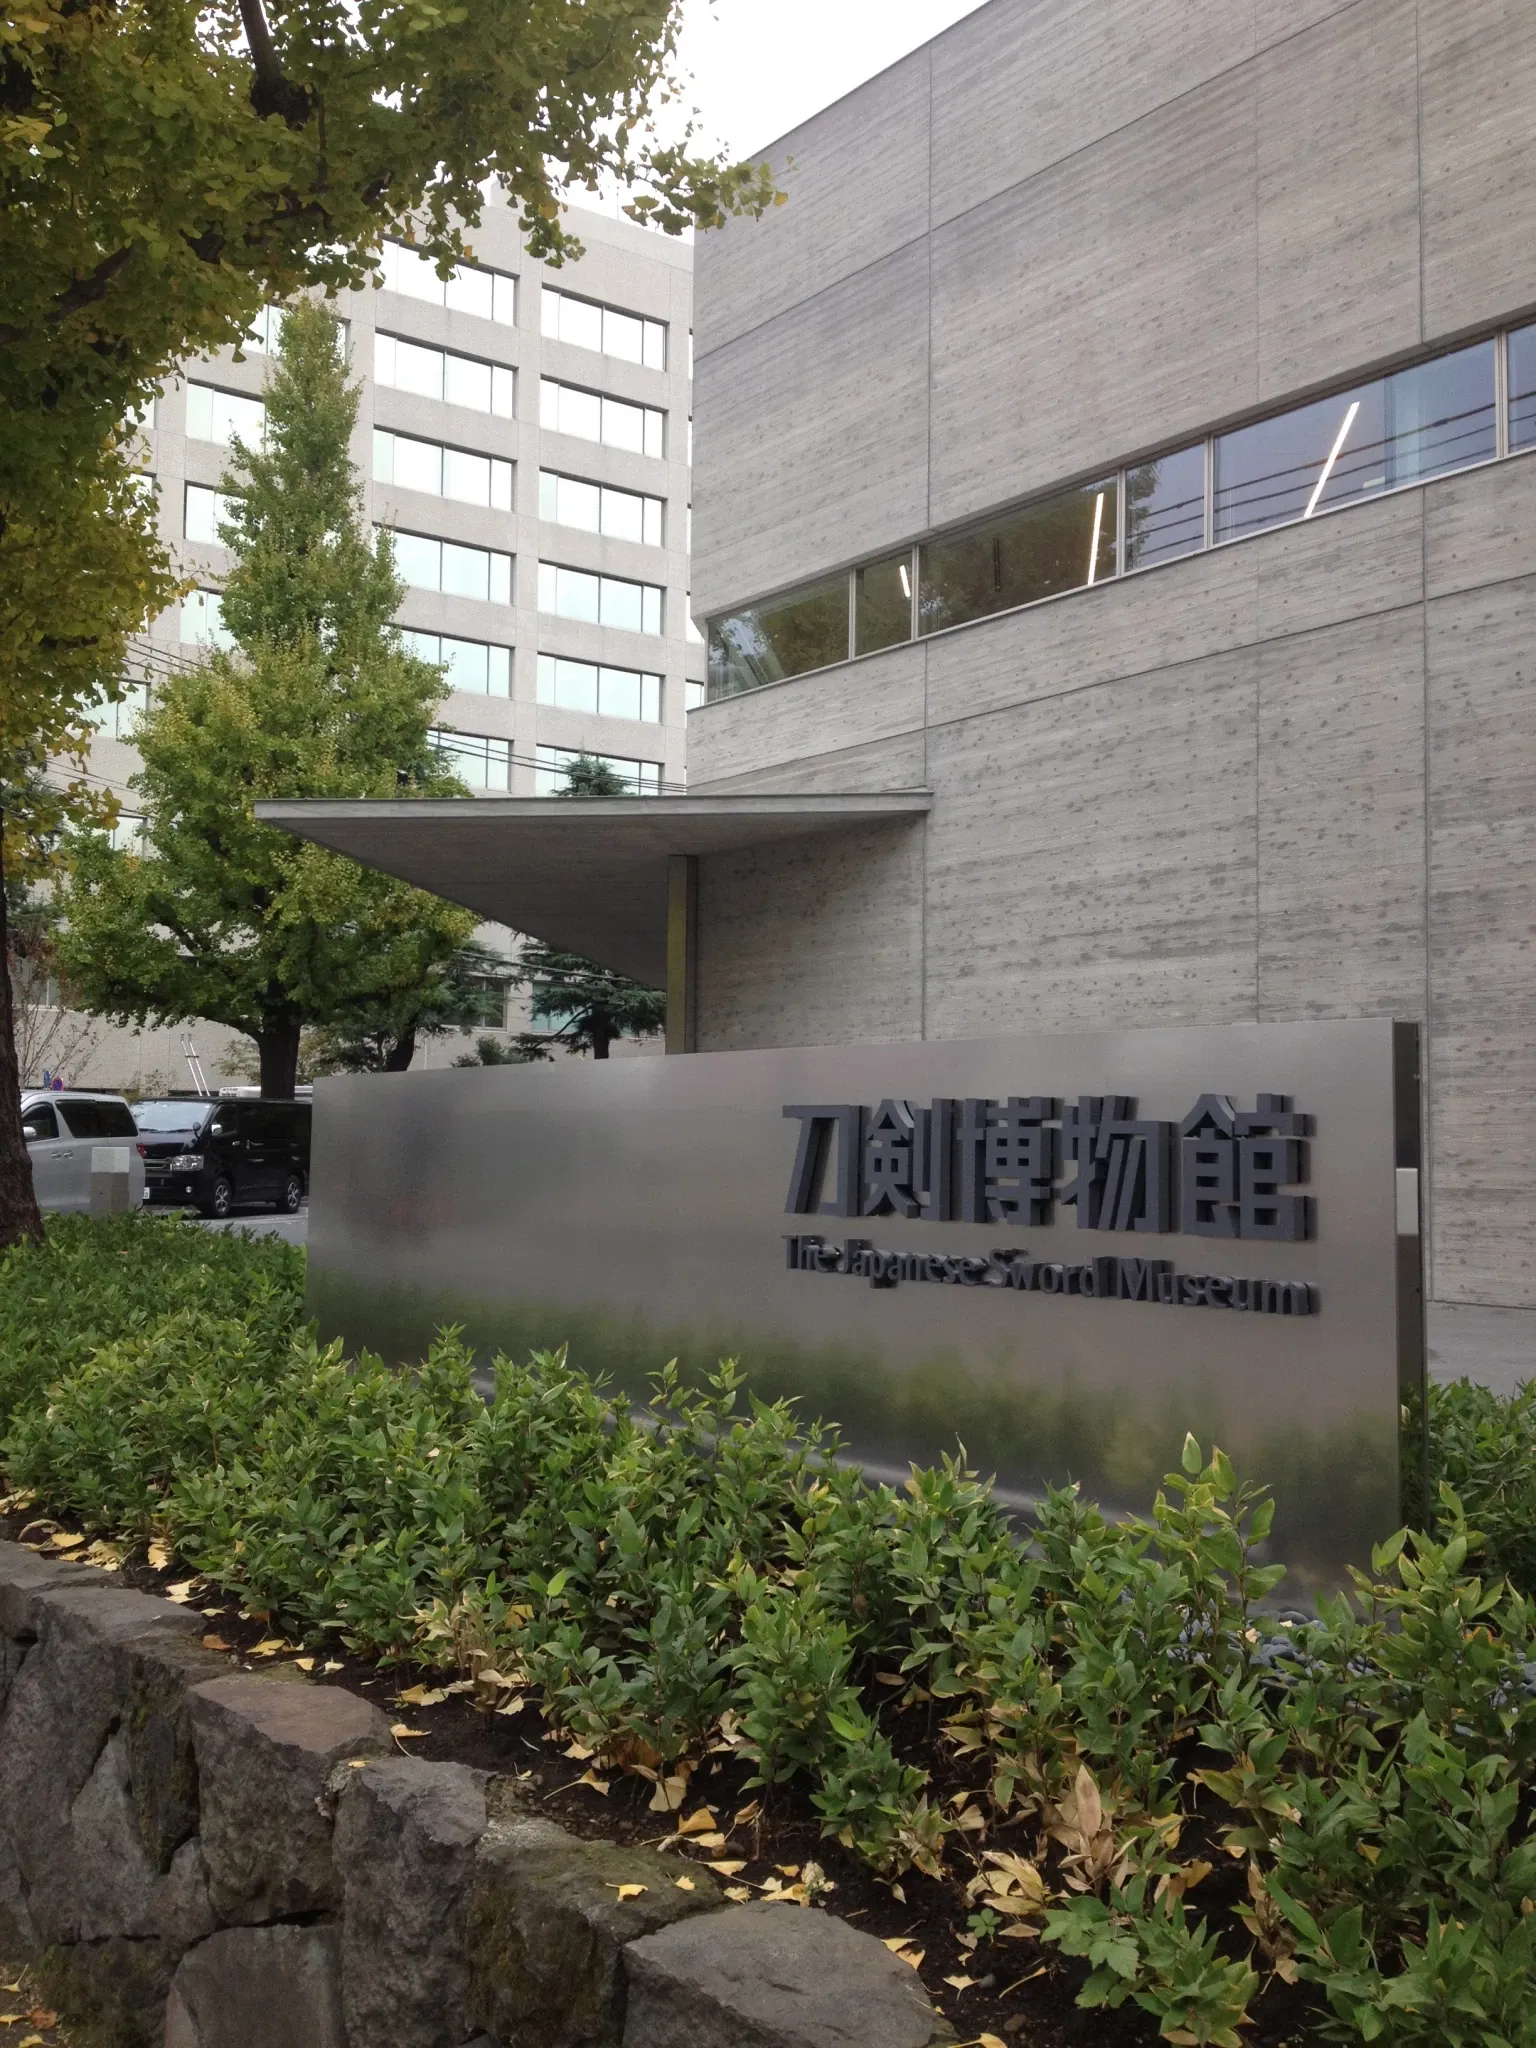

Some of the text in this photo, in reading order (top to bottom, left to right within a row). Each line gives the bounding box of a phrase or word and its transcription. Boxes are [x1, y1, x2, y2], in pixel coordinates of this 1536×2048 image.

[783, 1093, 1313, 1241] 刀剣博物館
[782, 1235, 1314, 1315] The Japanese Sword Museum
